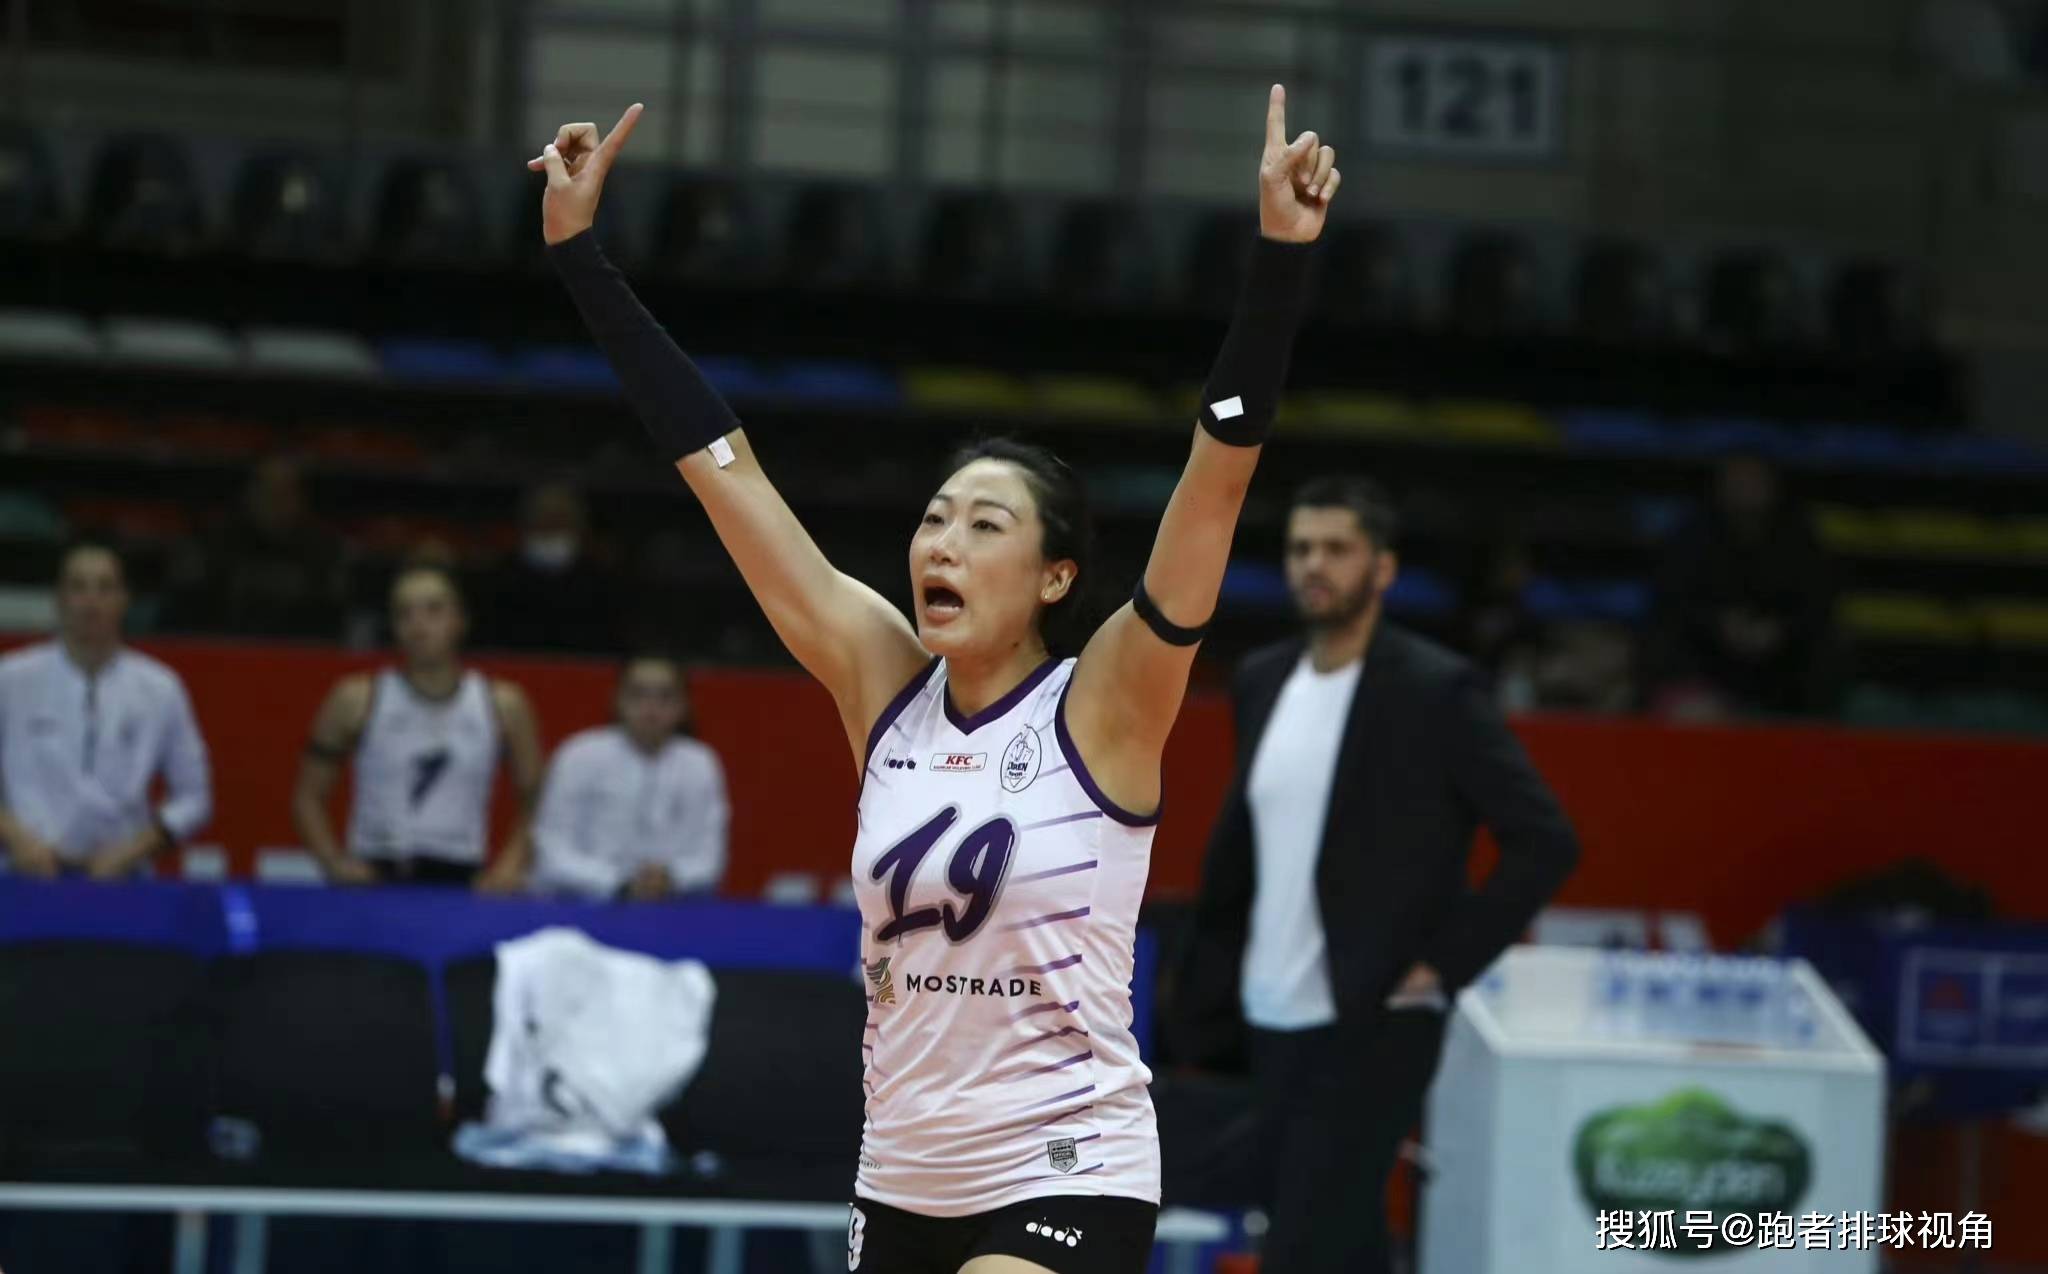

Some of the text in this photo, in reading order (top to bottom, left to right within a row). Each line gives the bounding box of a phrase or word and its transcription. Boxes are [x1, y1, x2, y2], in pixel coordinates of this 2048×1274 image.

[1395, 57, 1540, 142] 121
[945, 755, 974, 766] KFC
[869, 803, 1018, 944] 19
[905, 973, 1042, 997] MOSTRADE
